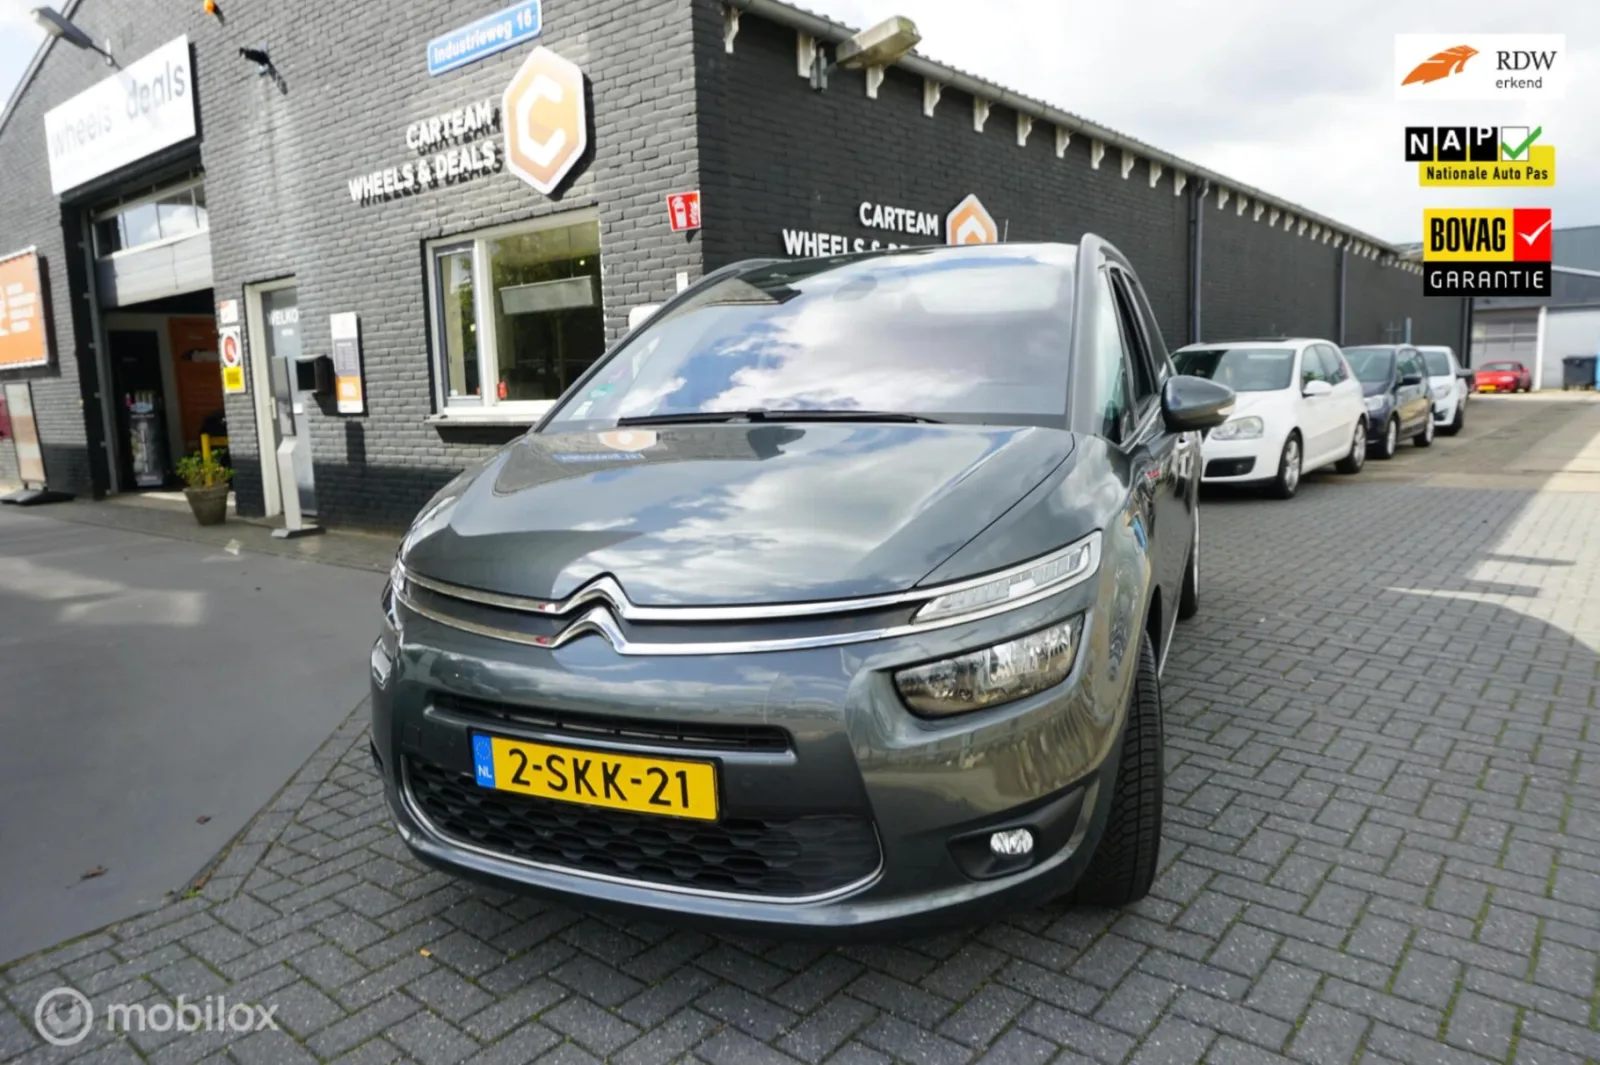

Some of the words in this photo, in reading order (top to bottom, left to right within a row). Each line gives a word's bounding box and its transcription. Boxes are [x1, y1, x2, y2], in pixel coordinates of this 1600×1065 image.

[434, 20, 512, 64] Industrieweg
[517, 8, 532, 30] 16
[51, 102, 112, 159] wheels
[126, 60, 186, 120] deals
[406, 99, 493, 149] CARTEAM
[348, 163, 414, 201] WHEELS
[418, 158, 432, 185] &
[435, 140, 496, 181] DEALS
[782, 228, 865, 257] WHEELS
[859, 201, 939, 236] CARTEAM
[478, 764, 493, 779] NL
[508, 748, 689, 808] 2-SKK-21
